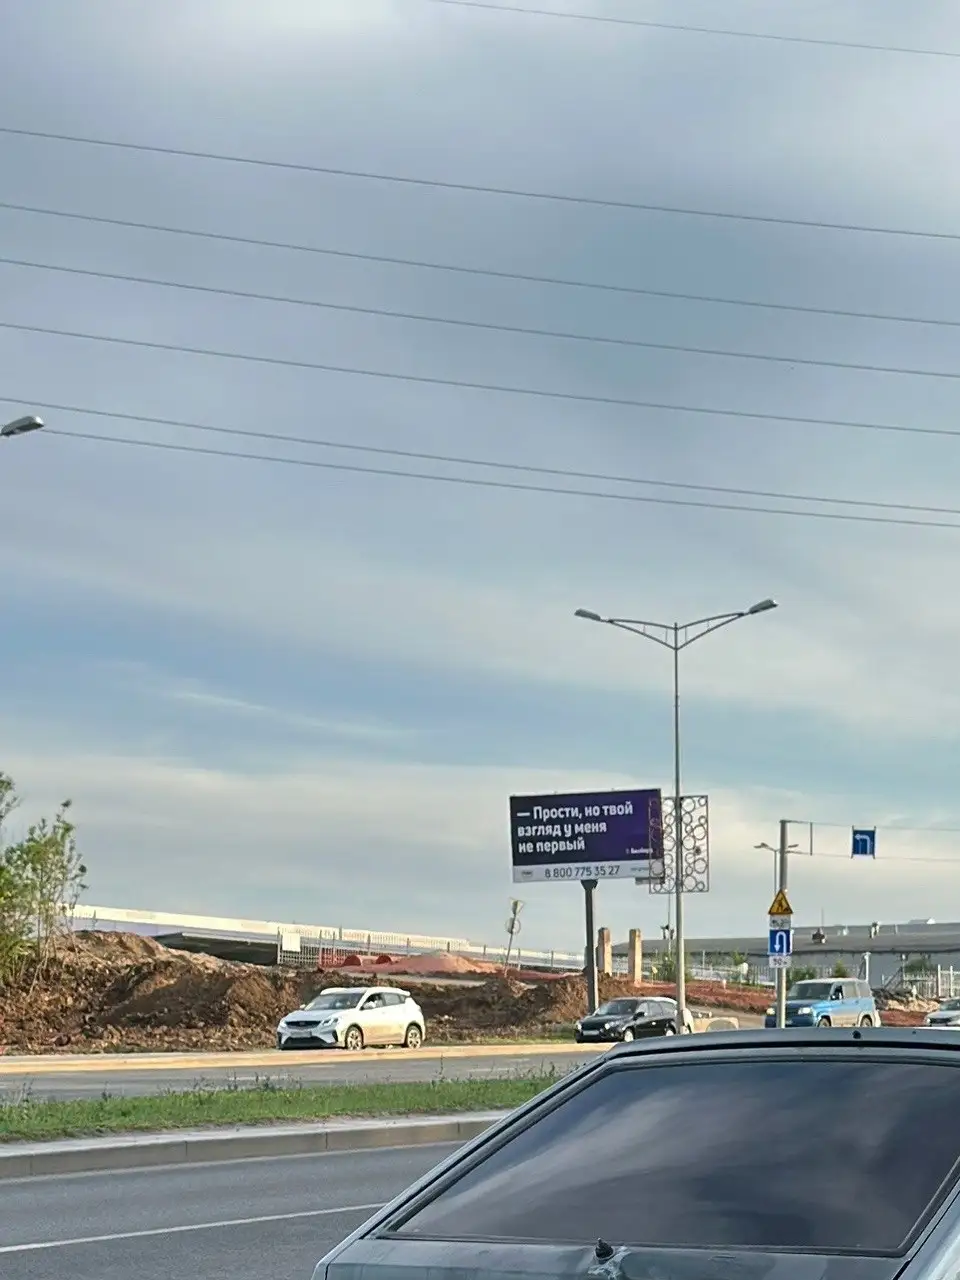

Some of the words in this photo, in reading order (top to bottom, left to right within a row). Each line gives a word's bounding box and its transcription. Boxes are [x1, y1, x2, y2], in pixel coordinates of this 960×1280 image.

[533, 806, 582, 822] Прости,
[585, 806, 600, 817] но
[602, 801, 634, 816] твой
[517, 823, 562, 838] взгляд
[564, 824, 572, 838] у
[574, 822, 607, 834] меня
[518, 841, 534, 853] не
[536, 837, 585, 855] первый
[544, 868, 550, 878] 8
[553, 867, 572, 878] 800
[575, 866, 592, 877] 775
[594, 866, 606, 876] 35
[608, 865, 620, 876] 27
